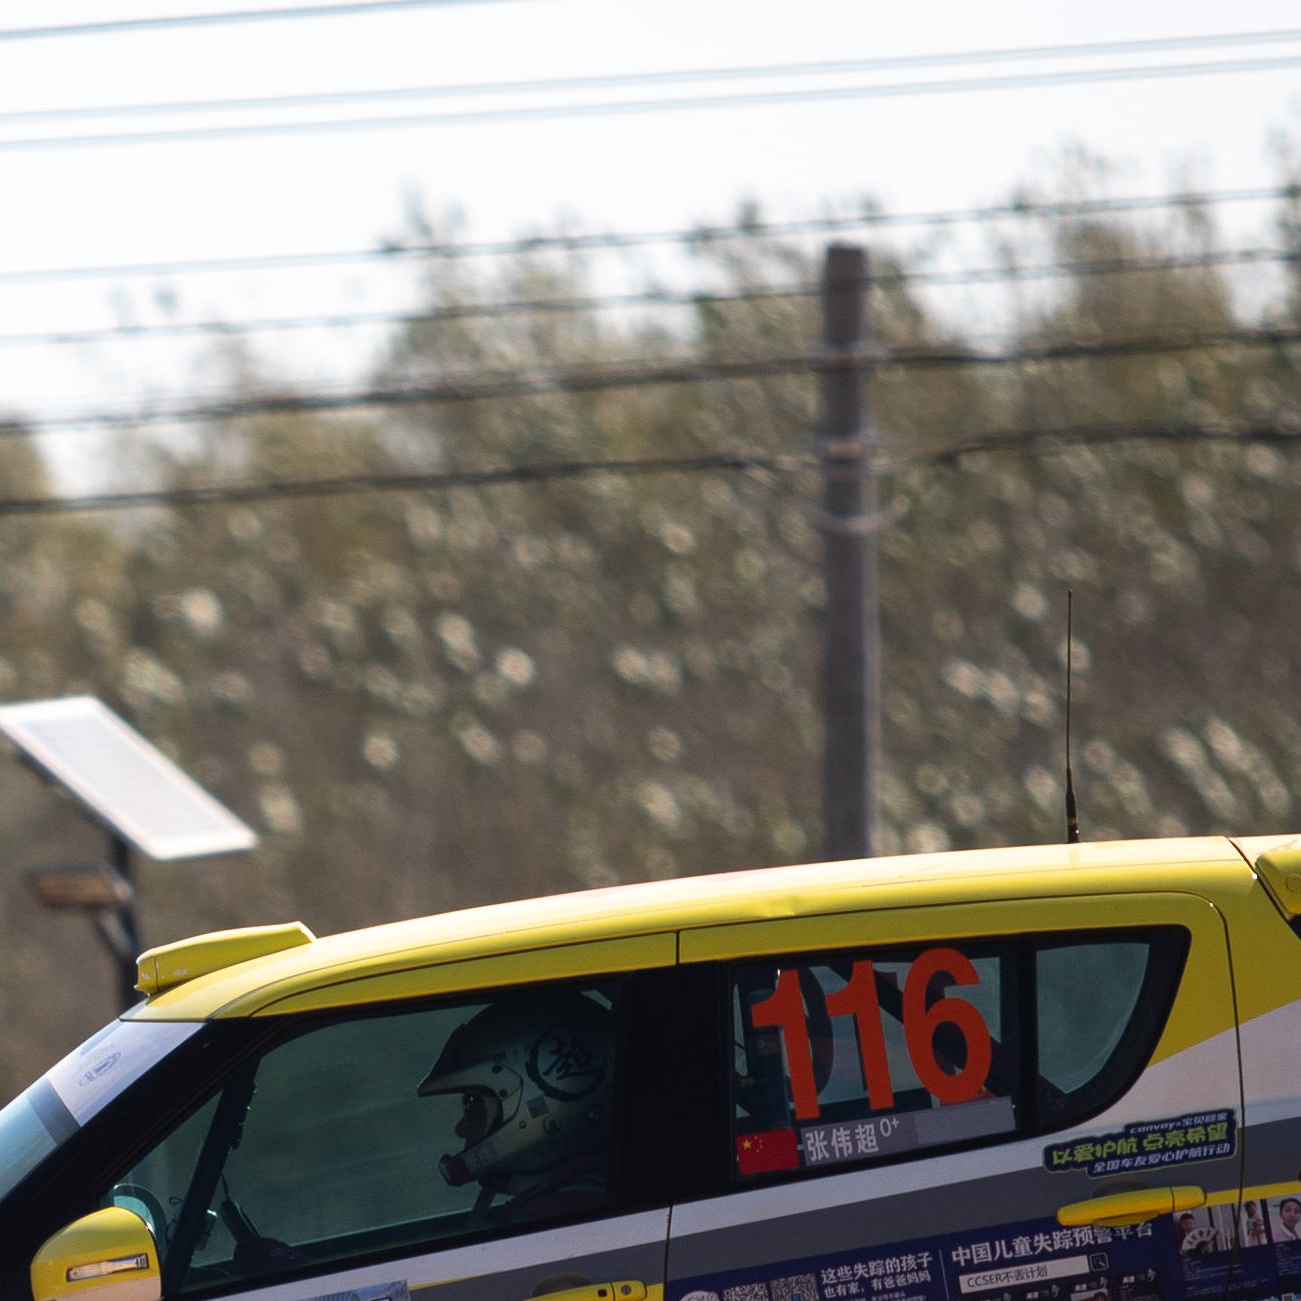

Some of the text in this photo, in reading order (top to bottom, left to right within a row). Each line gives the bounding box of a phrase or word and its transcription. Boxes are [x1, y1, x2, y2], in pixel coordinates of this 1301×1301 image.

[751, 947, 991, 1120] 116
[806, 1124, 879, 1162] 张伟超
[1052, 1122, 1228, 1165] 以爱护航 点亮希望
[1092, 1143, 1231, 1174] 全国车友爱心护航行动
[820, 1252, 933, 1285] 这些失踪的孩子
